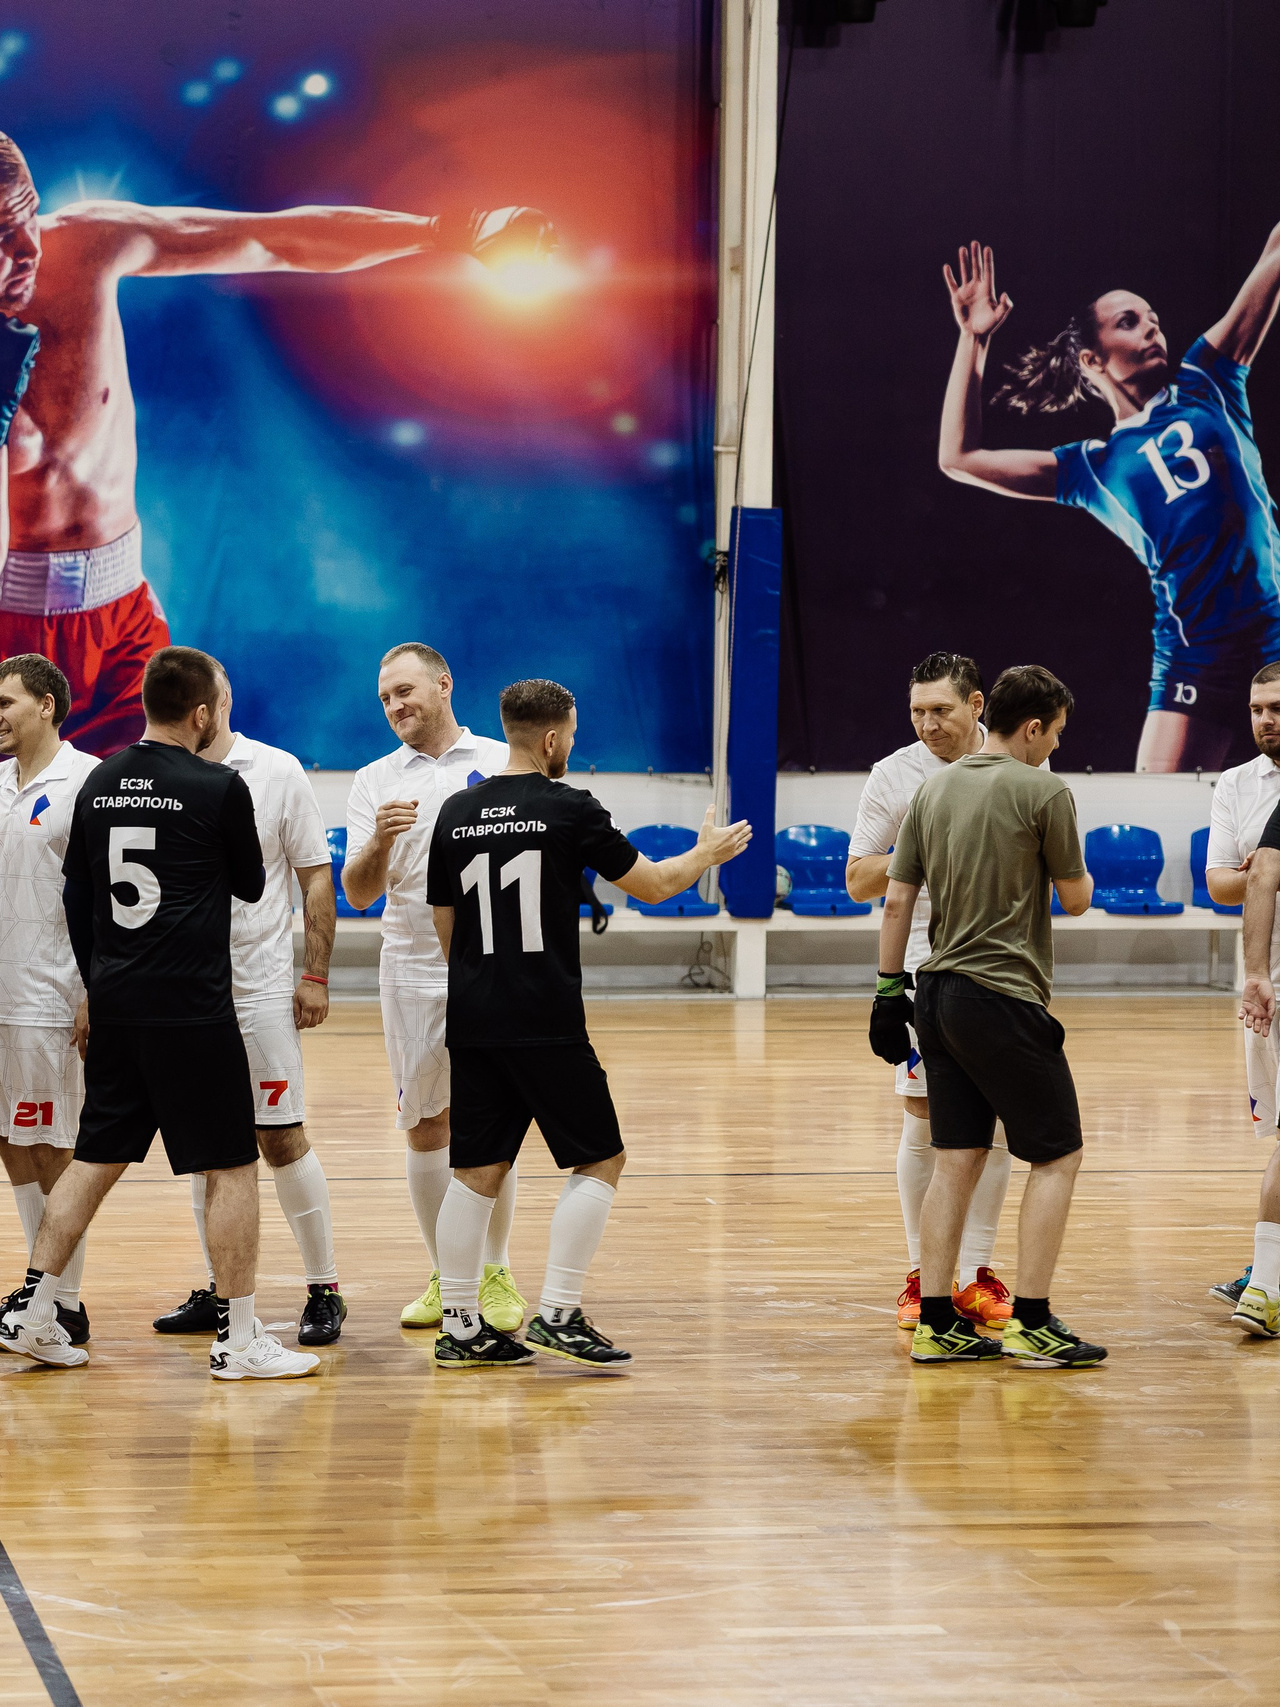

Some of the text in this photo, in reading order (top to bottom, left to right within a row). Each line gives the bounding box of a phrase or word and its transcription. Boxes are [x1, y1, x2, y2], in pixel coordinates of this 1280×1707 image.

[1136, 420, 1211, 505] 13
[93, 796, 184, 811] СТАВРОПОЛЬ
[452, 820, 548, 840] СТАВРОПОЛЬ
[108, 826, 161, 930] 5
[459, 849, 545, 955] 11
[259, 1080, 288, 1106] 7
[13, 1101, 54, 1127] 21
